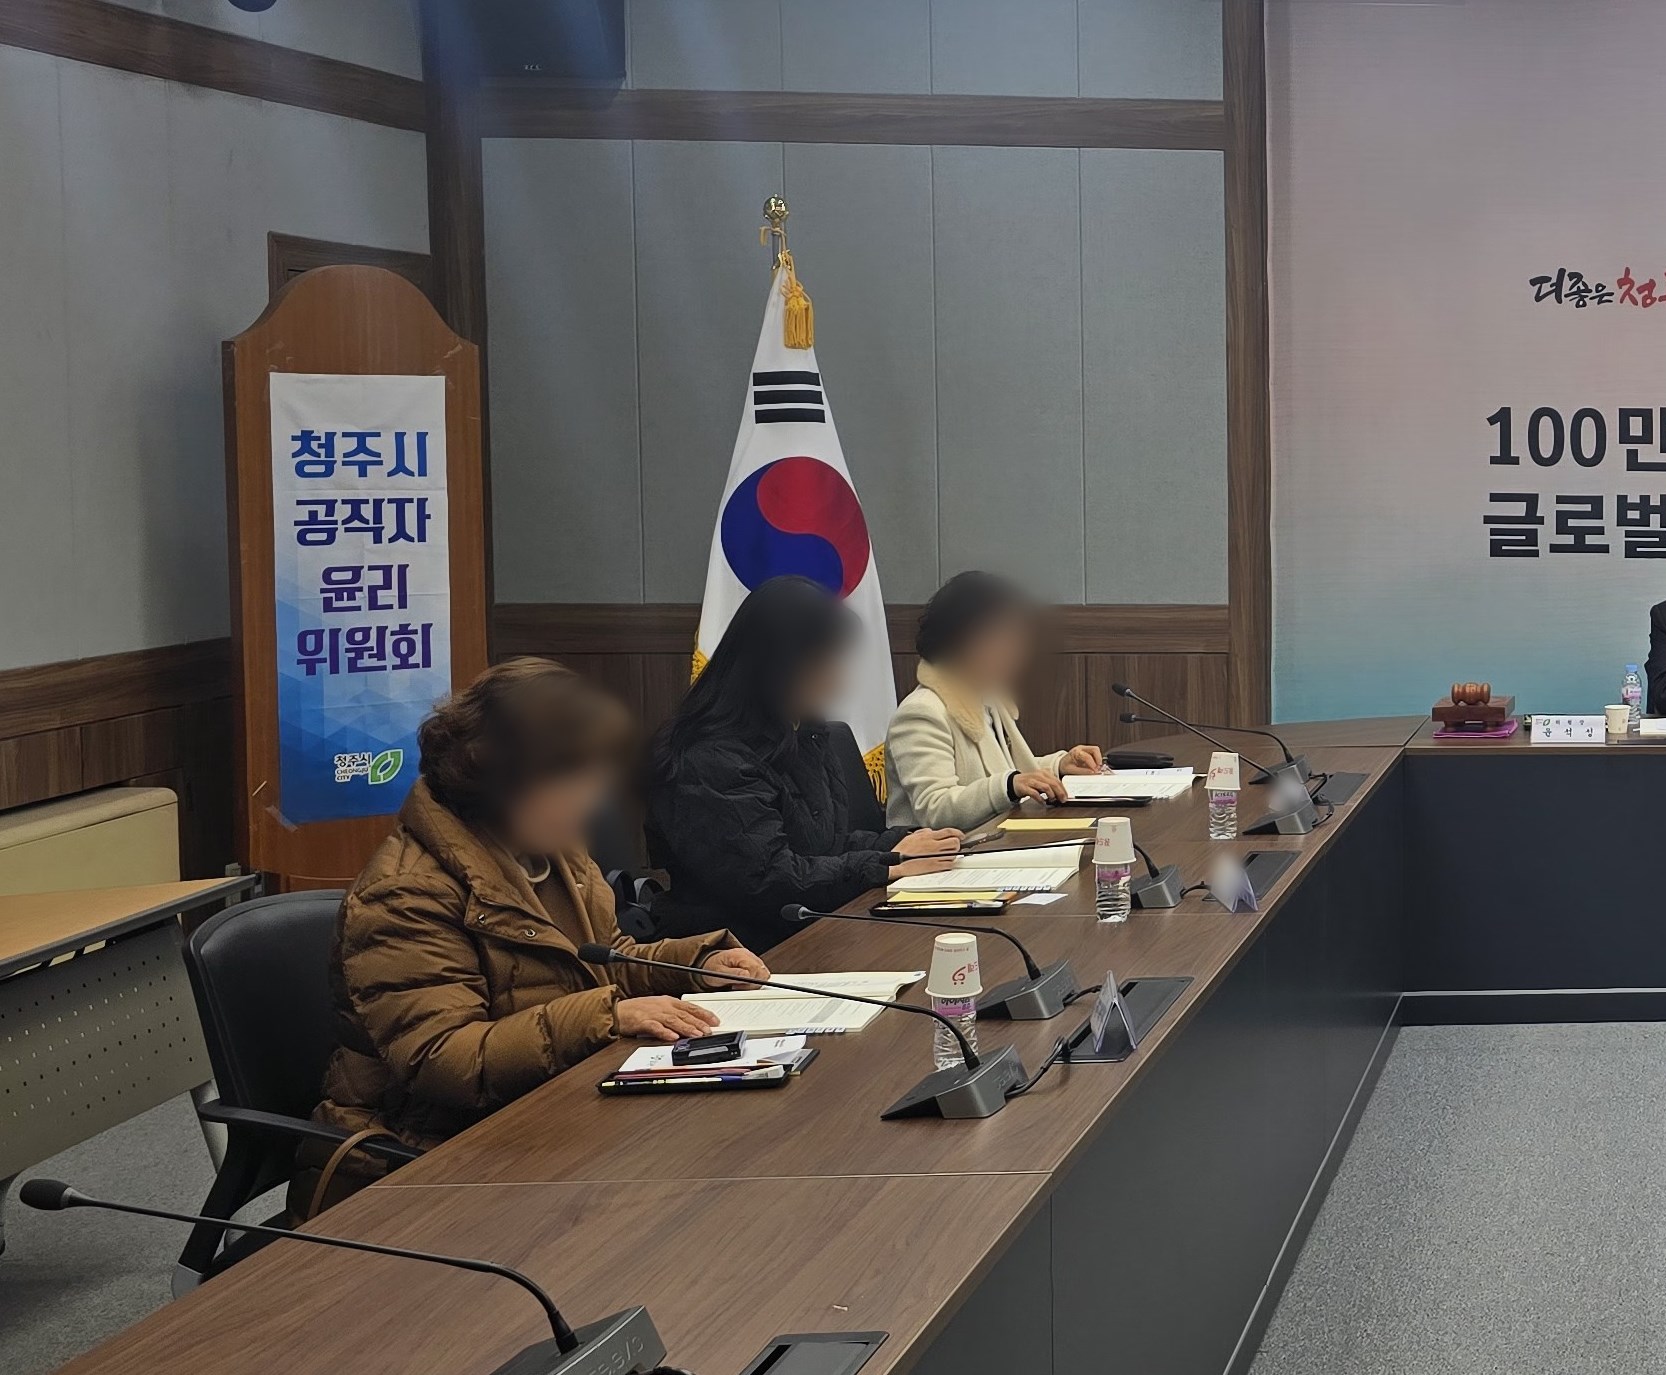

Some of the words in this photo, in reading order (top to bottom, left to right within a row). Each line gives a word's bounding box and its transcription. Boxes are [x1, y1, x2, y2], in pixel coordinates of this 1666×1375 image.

[291, 430, 428, 478] 청주시
[293, 497, 431, 545] 공직자
[319, 564, 409, 613] 윤리
[296, 622, 432, 676] 위원회
[335, 753, 371, 767] 청주시
